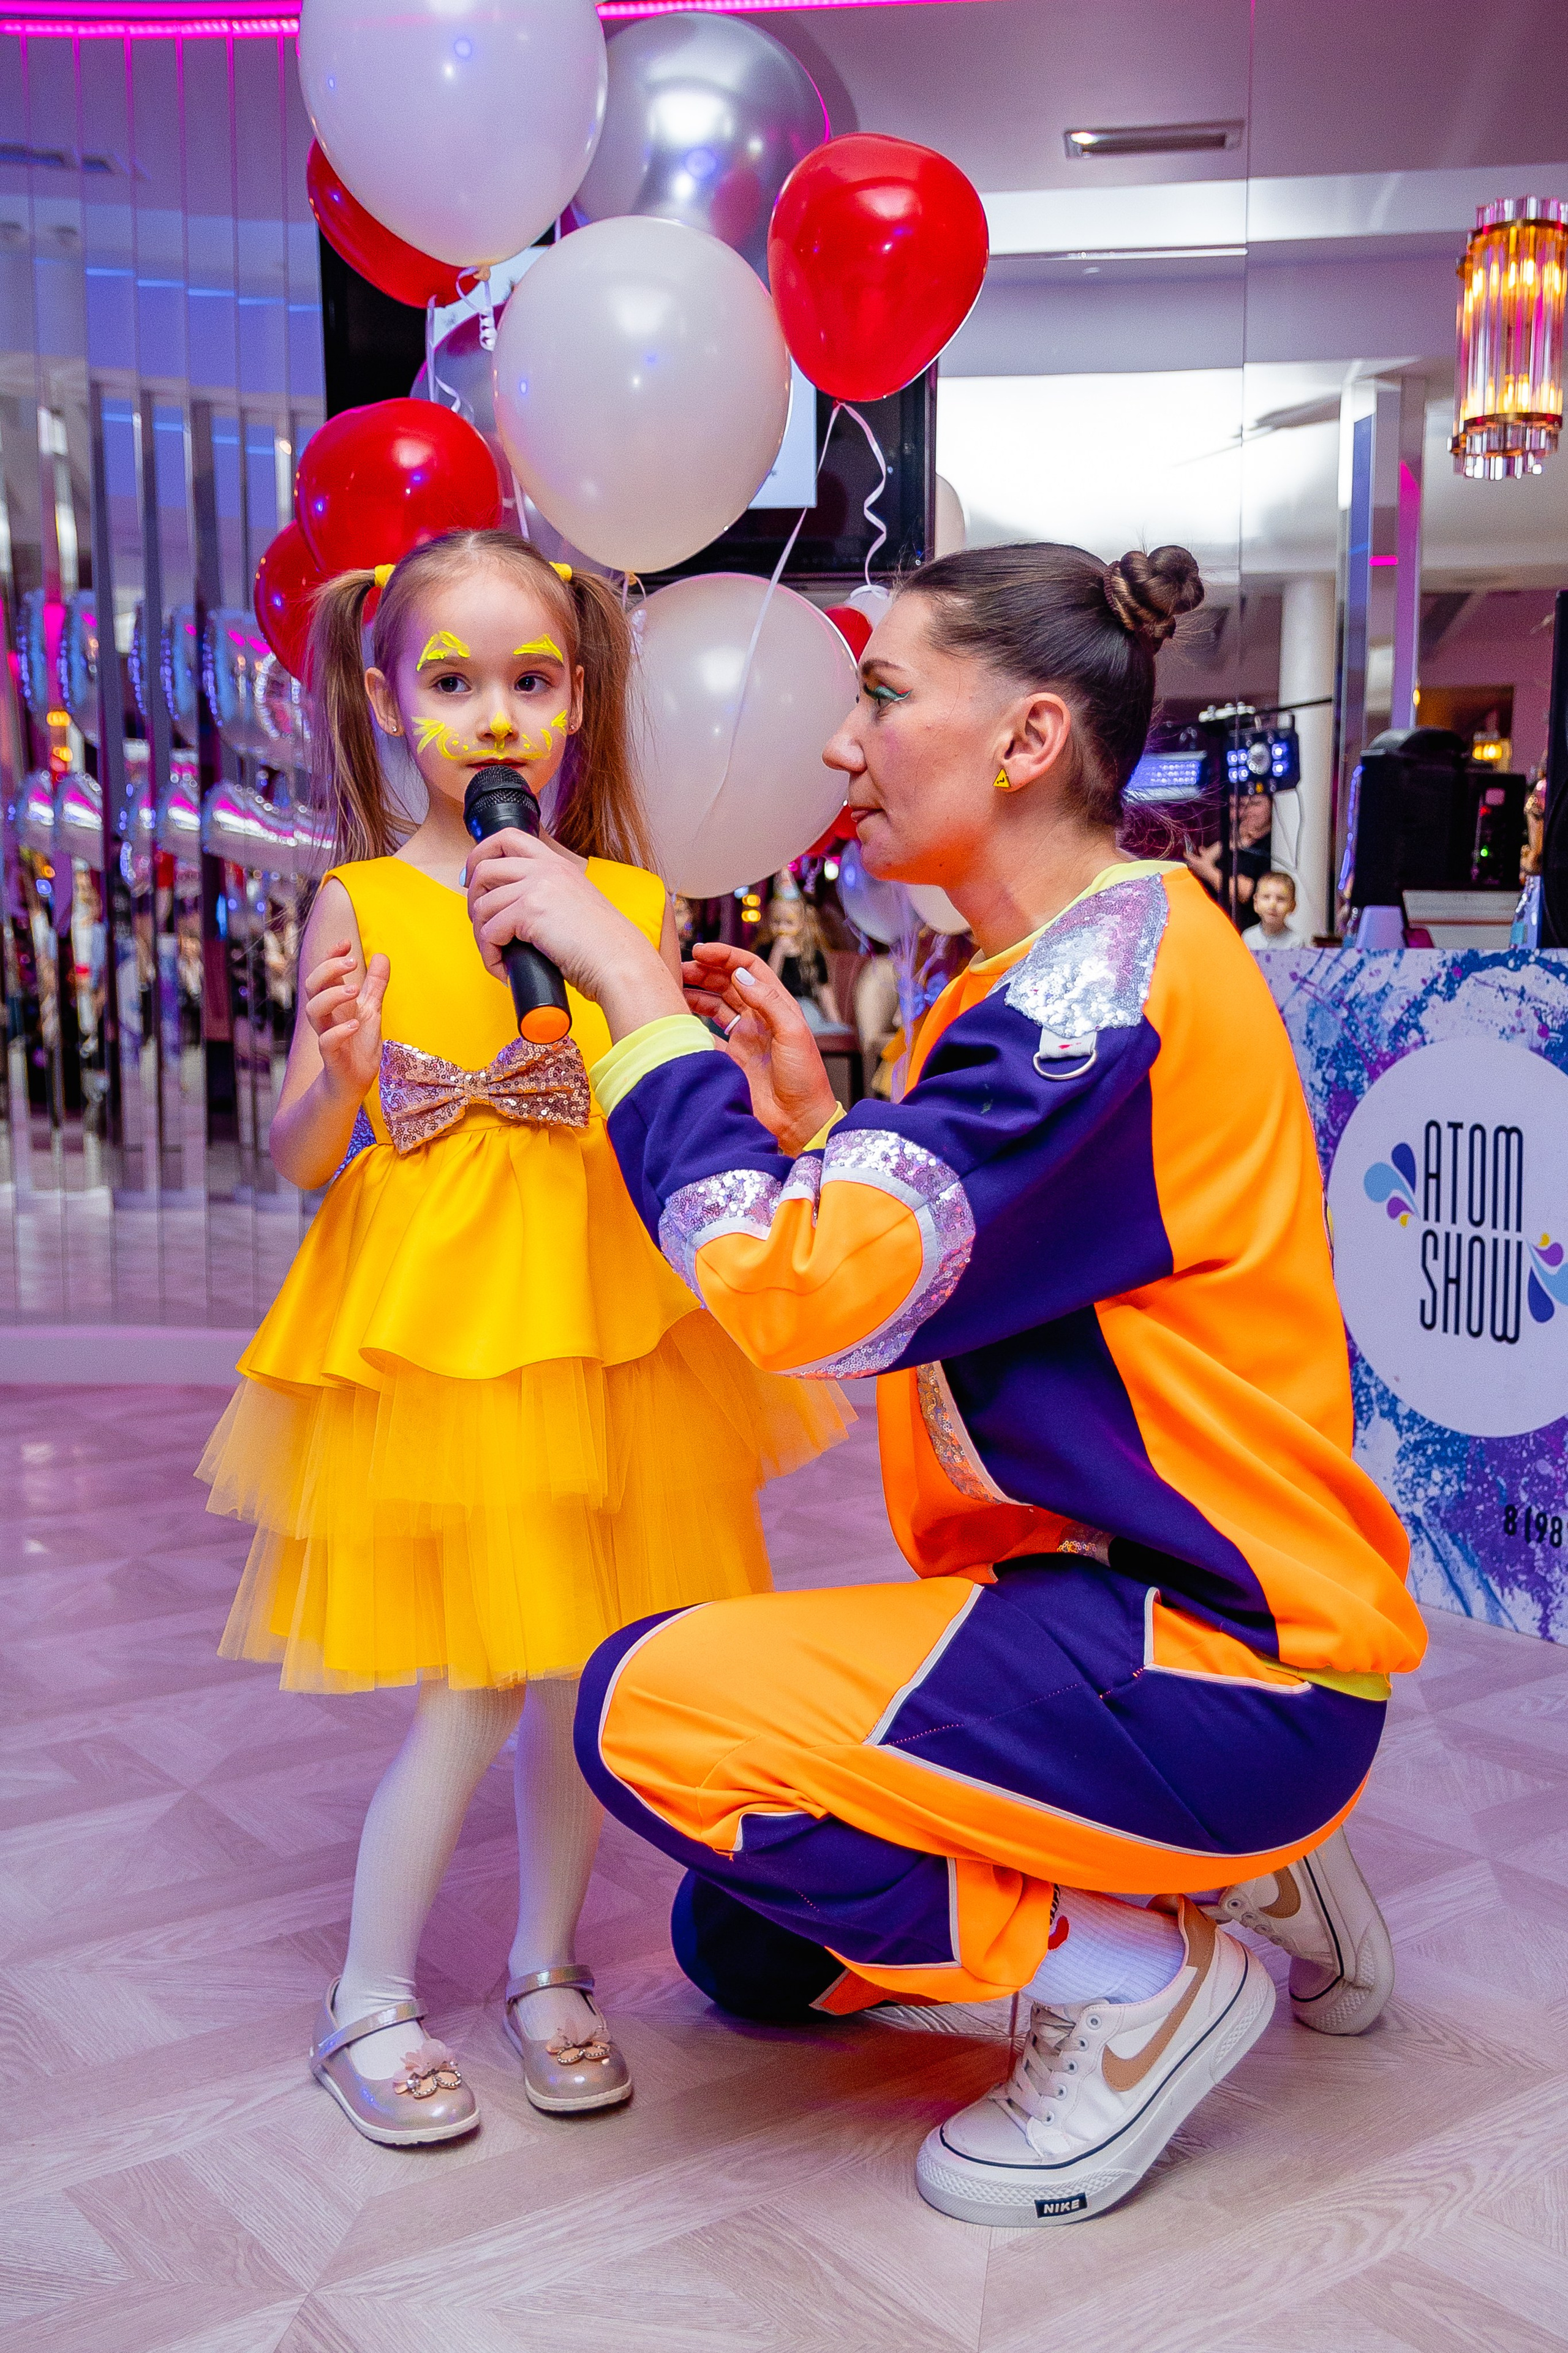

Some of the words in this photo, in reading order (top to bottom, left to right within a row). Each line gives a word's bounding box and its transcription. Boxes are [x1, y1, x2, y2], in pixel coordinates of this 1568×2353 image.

[1424, 1120, 1523, 1233] ATOM
[1420, 1229, 1523, 1344] SHOW
[1043, 2199, 1080, 2214] NIKE
